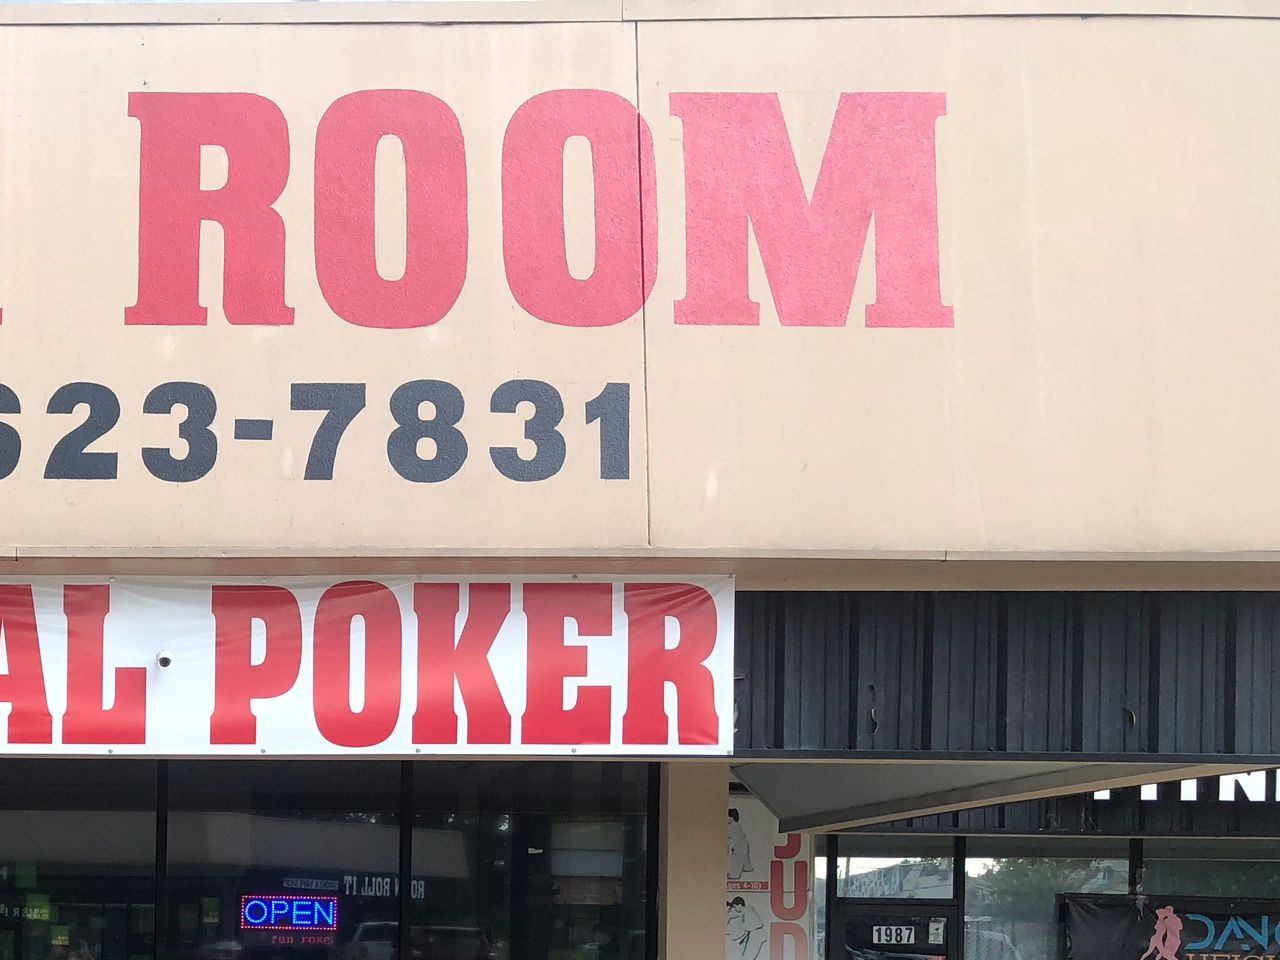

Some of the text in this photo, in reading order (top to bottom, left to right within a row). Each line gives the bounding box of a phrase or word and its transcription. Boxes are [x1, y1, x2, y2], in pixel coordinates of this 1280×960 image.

[123, 87, 954, 329] ROOM
[209, 579, 719, 748] POKER
[244, 900, 334, 925] OPEN
[874, 926, 914, 943] 1987
[1184, 913, 1280, 950] DAN
